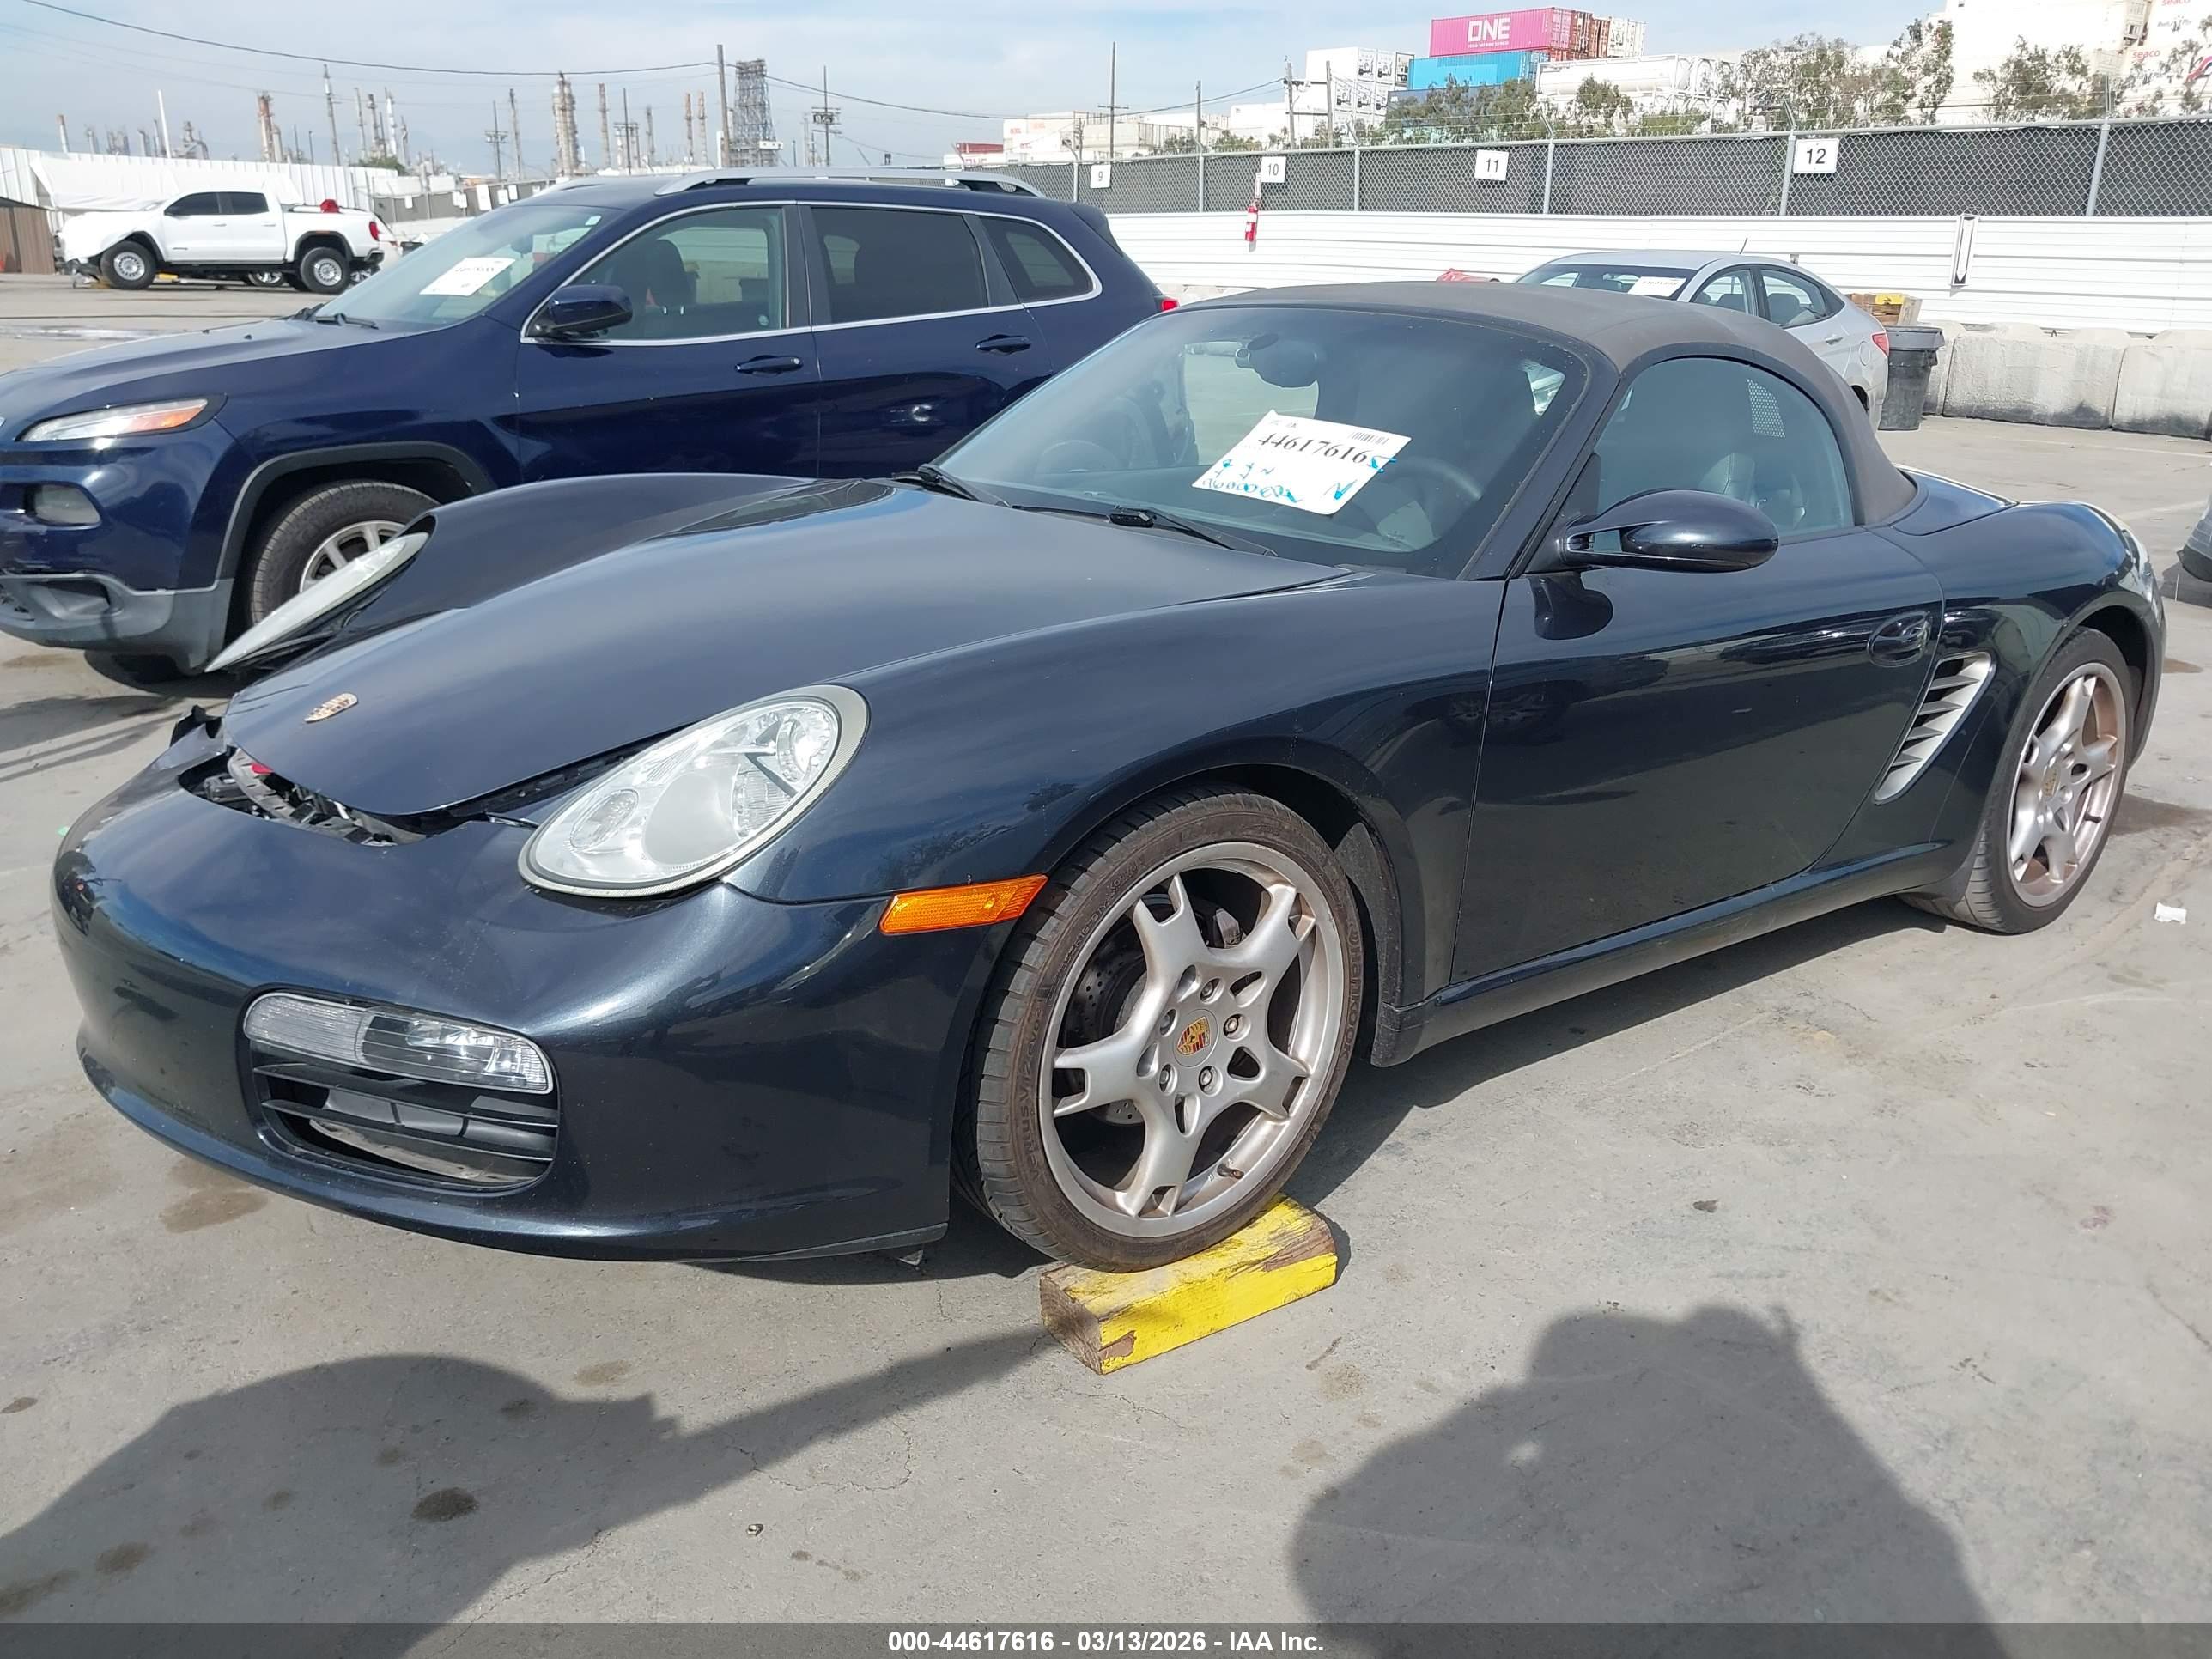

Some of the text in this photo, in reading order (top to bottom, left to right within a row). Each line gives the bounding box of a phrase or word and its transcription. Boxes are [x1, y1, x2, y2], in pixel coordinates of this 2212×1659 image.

[1468, 17, 1510, 42] ONE
[2132, 50, 2161, 59] seaco
[1807, 148, 1826, 165] 12
[1267, 163, 1279, 176] 10
[1486, 157, 1499, 173] 11
[1097, 171, 1104, 182] 9
[1257, 432, 1373, 465] 44617616
